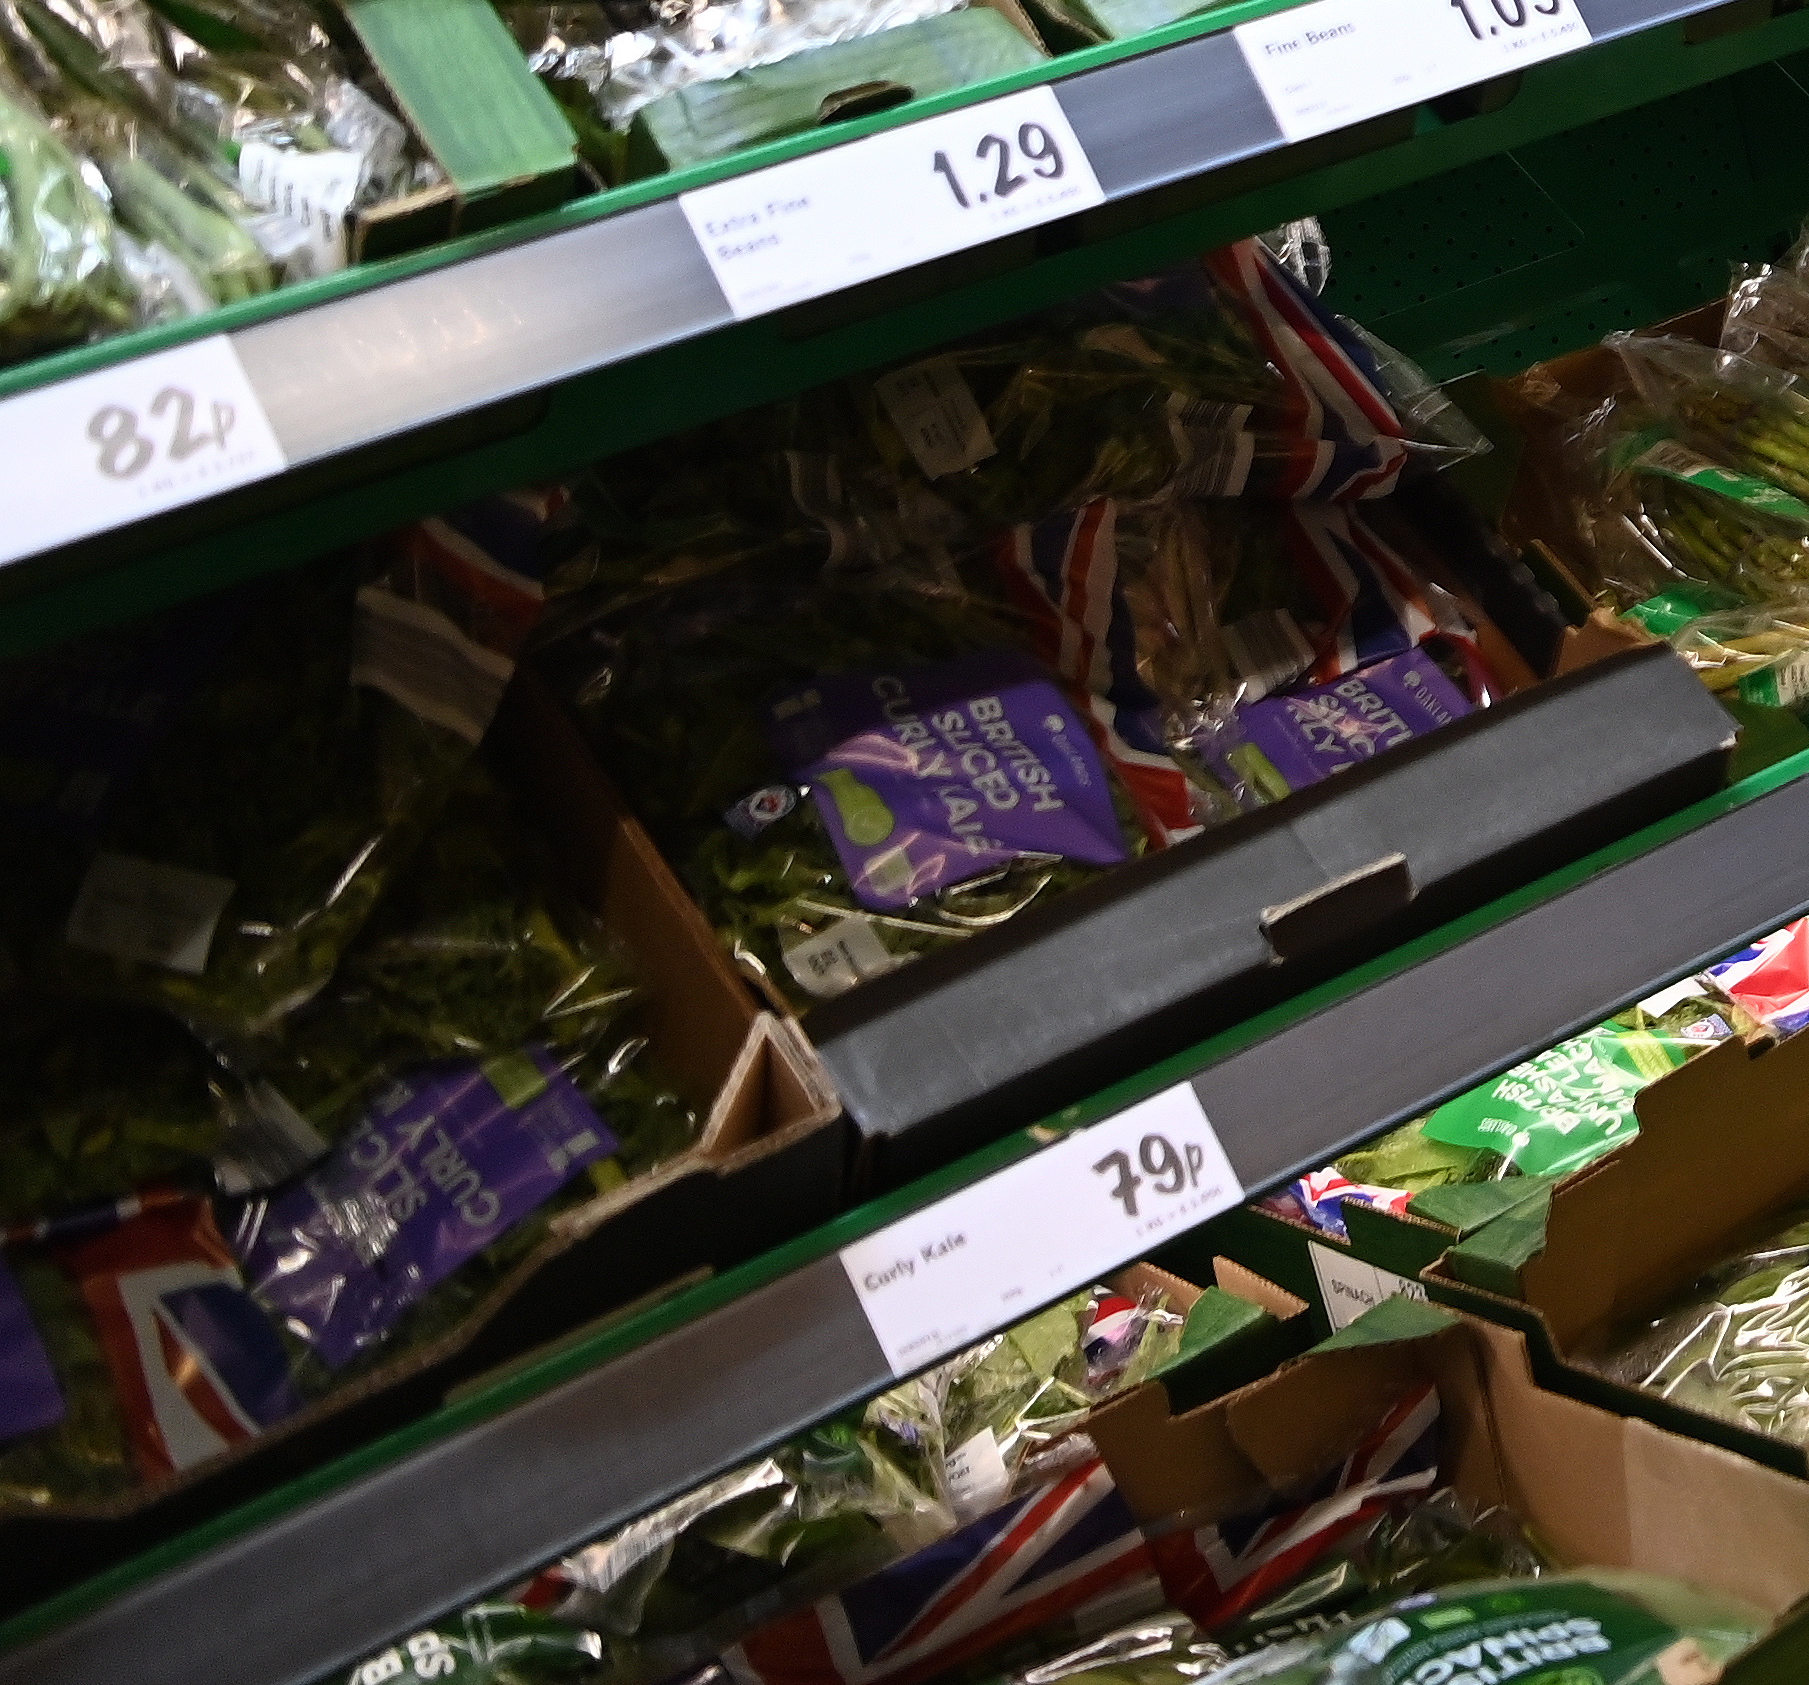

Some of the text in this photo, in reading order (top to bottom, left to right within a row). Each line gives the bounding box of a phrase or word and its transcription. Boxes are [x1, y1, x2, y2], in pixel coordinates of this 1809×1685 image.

[1265, 22, 1356, 56] Fine Beans
[934, 122, 1066, 209] 1.29
[715, 233, 781, 261] Beans
[87, 386, 235, 481] 82p
[931, 709, 1021, 811] SLICED
[1093, 1134, 1205, 1216] 79p
[863, 1230, 968, 1293] Curly Kale
